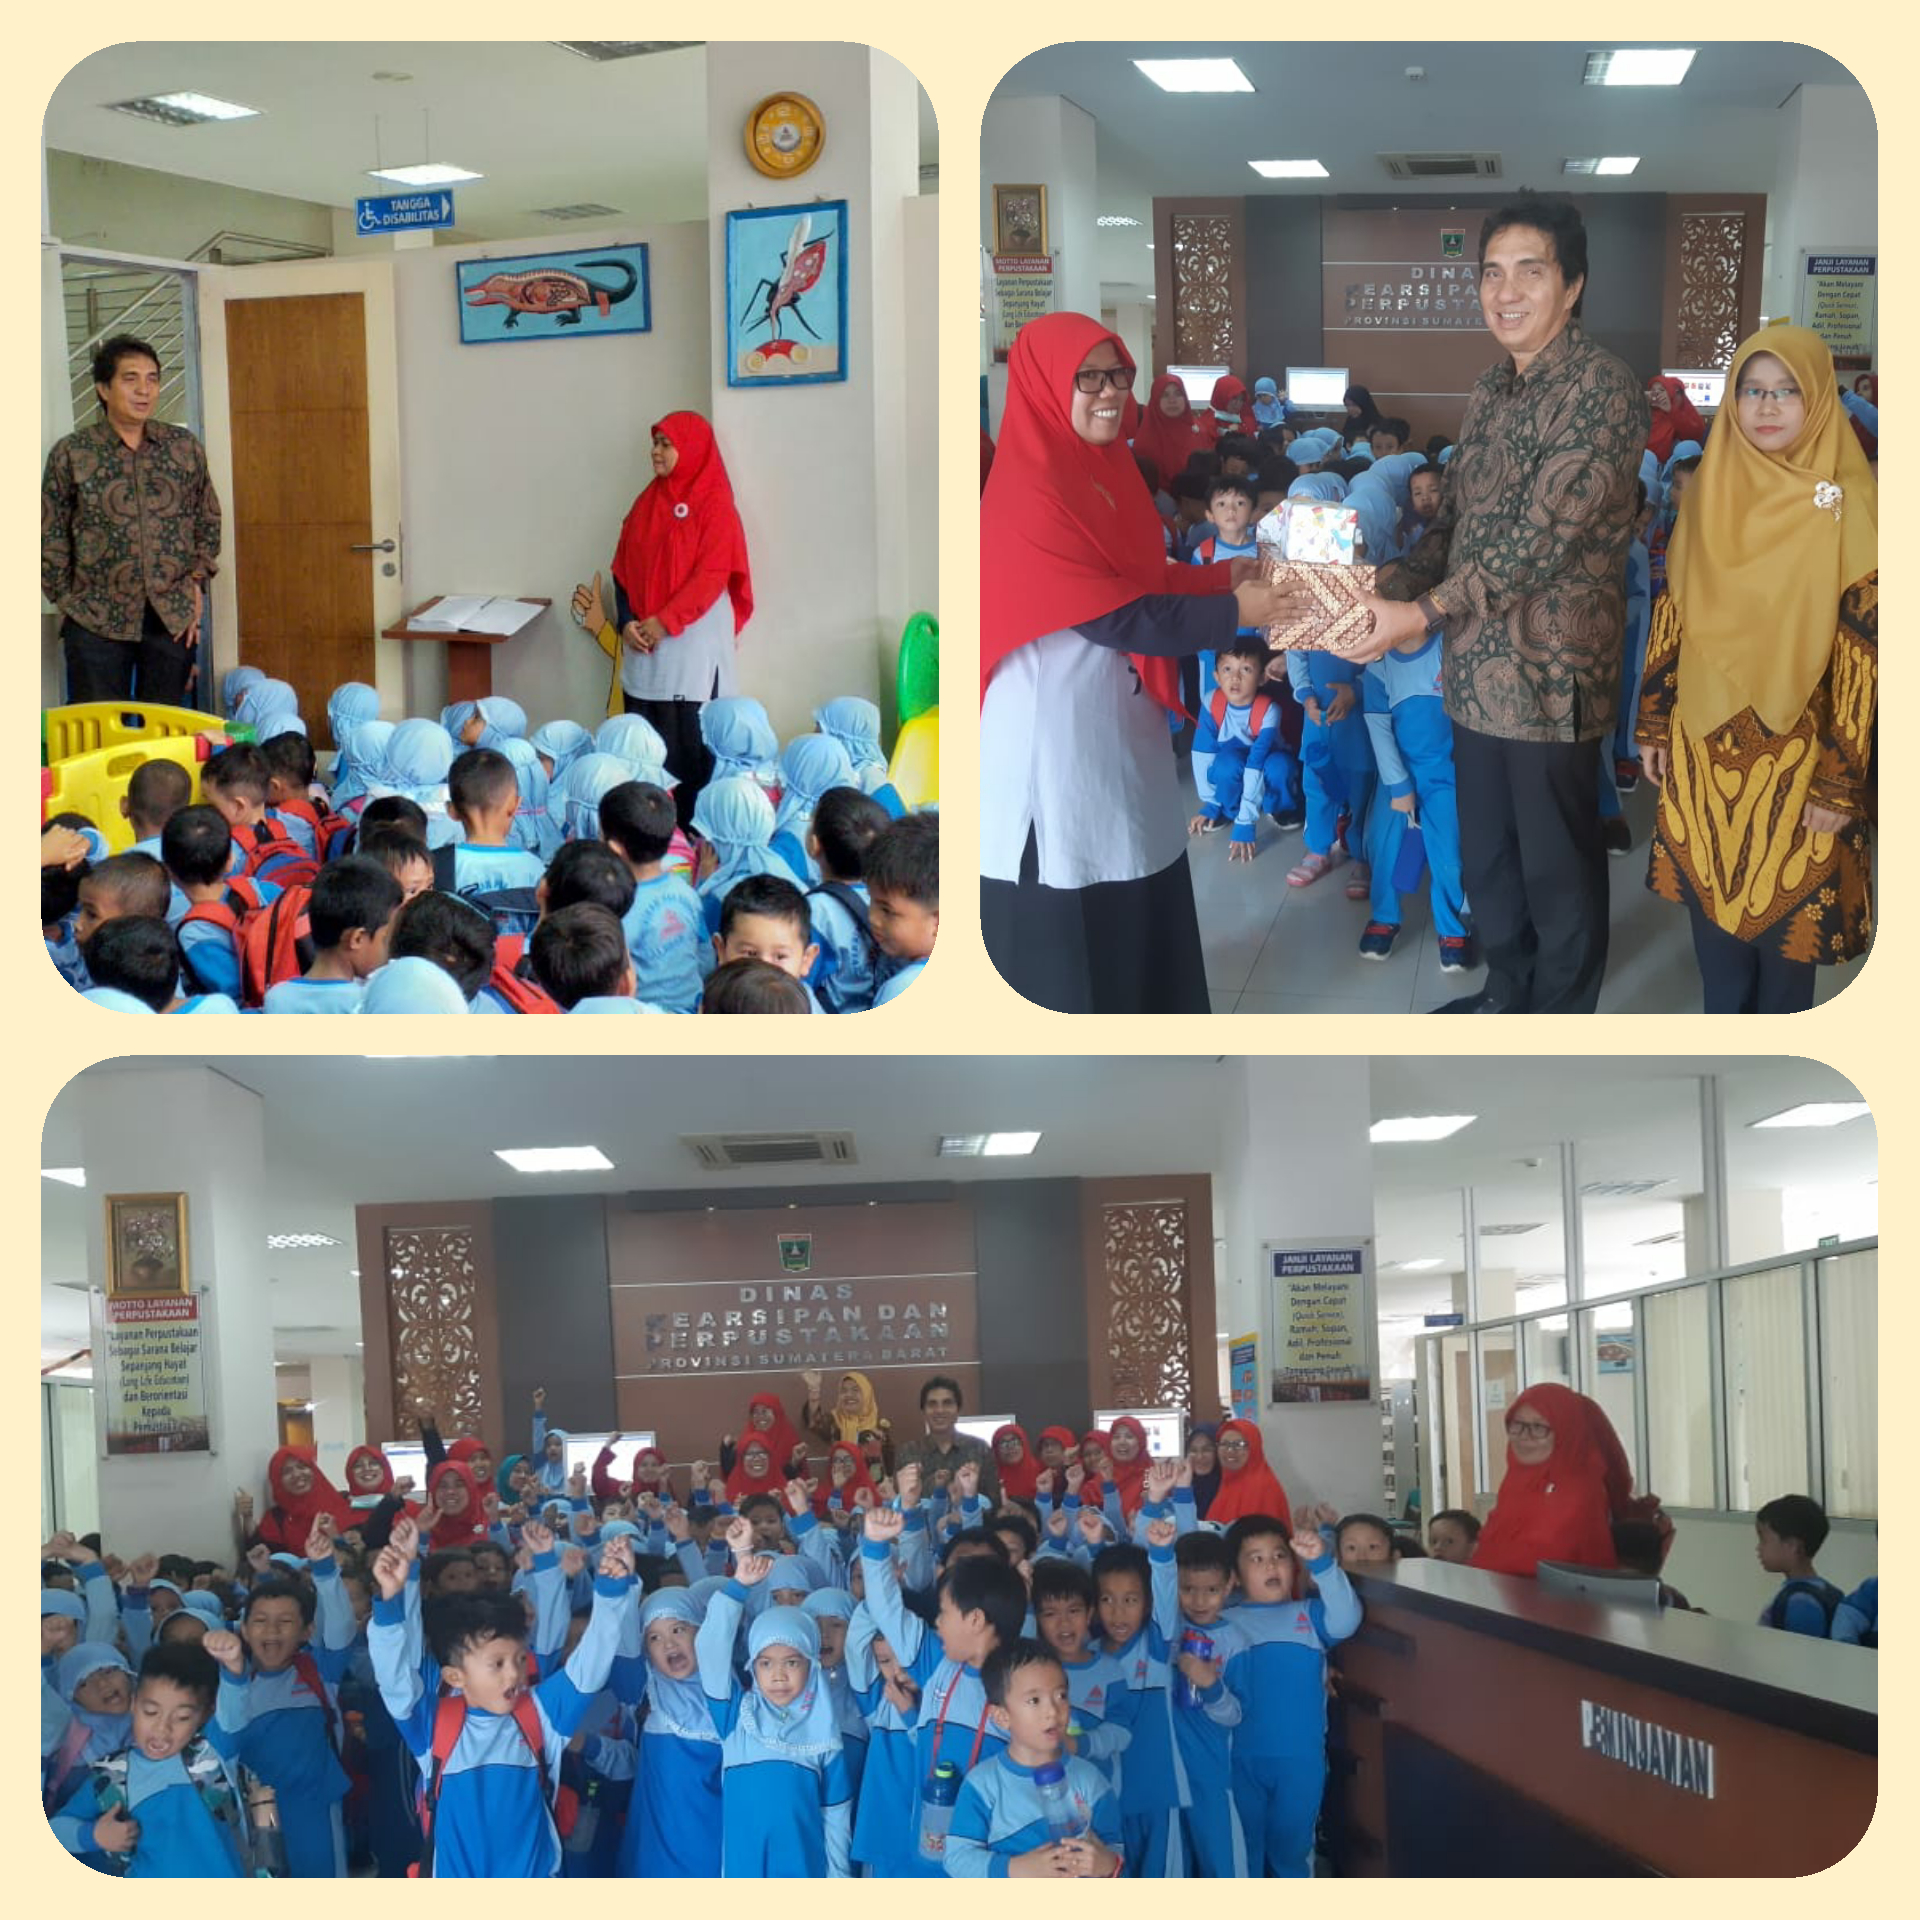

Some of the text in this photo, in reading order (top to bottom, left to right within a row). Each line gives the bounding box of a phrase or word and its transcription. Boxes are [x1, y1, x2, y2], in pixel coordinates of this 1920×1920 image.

[391, 196, 431, 211] TANGGA
[383, 209, 440, 226] DISABILITAS
[1020, 257, 1050, 265] LAYANAN
[1814, 258, 1870, 266] JANJI LAYANAN
[998, 264, 1048, 272] PERPUSTAKAAN
[1411, 266, 1475, 279] DINA
[1812, 266, 1870, 274] PERPUSTAKAAN
[1346, 284, 1479, 296] KEARSIPA
[1345, 298, 1482, 311] PERPUSTA
[1422, 316, 1483, 326] SUMATE
[1282, 1252, 1353, 1264] JANJI LAYANAN
[1281, 1263, 1354, 1275] PERPUSTAKAAN
[739, 1283, 853, 1303] DINAS
[111, 1297, 193, 1310] MOTTO LAYANAN
[113, 1308, 190, 1320] PERPUSTAKAAN
[877, 1302, 947, 1320] DAN
[144, 1327, 200, 1342] Perpustakaan
[645, 1322, 948, 1351] PERPUSTAKAAN
[141, 1343, 169, 1355] Sarana
[170, 1342, 198, 1357] Belajar
[758, 1351, 873, 1366] SUMATERA
[880, 1347, 948, 1361] BARAT
[120, 1359, 187, 1373] Sepanjang Hayat
[123, 1389, 189, 1402] dan Berorientasi
[141, 1405, 172, 1418] Kepada
[1580, 1698, 1715, 1800] PEMINJAMAN
